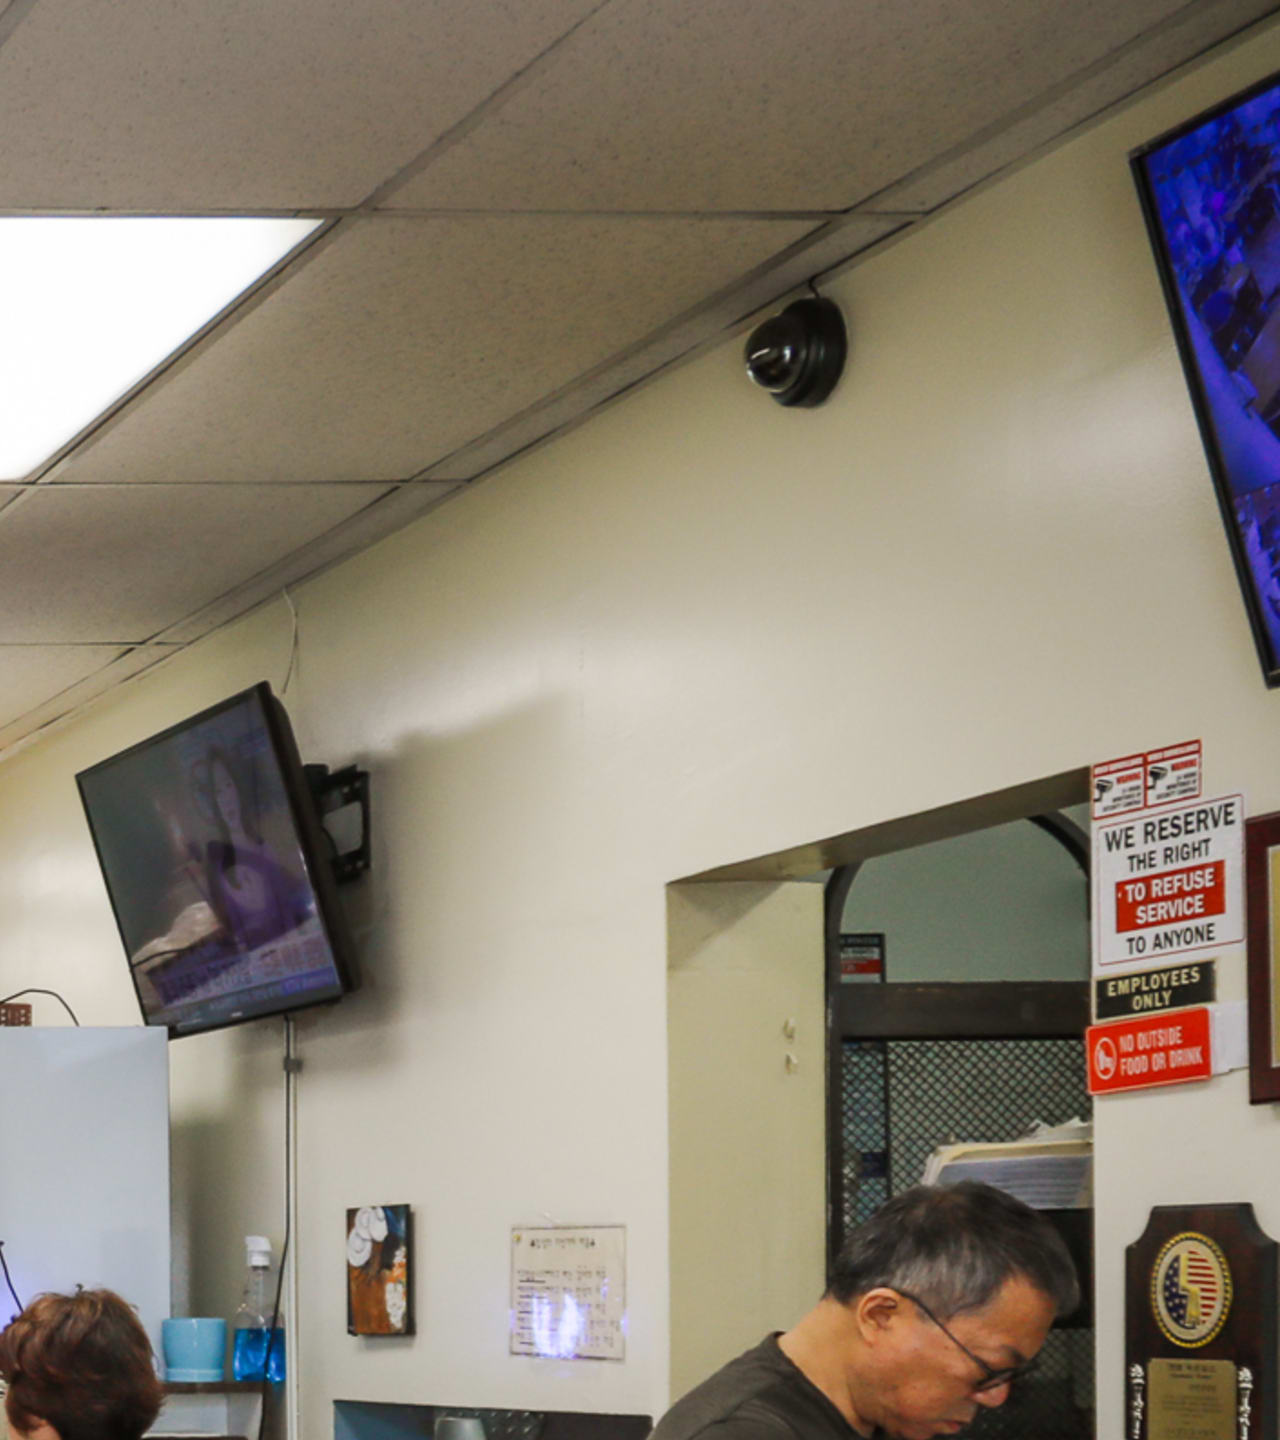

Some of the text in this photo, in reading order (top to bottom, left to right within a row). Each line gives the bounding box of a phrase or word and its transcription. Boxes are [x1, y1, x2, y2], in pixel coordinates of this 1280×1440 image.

[1105, 803, 1236, 852] WE RESERVE
[1128, 838, 1211, 872] THE RIGHT
[1125, 868, 1215, 903] TO REFUSE
[1135, 894, 1205, 925] SERVICE
[1126, 923, 1215, 955] TO ANYONE
[1107, 966, 1200, 997] EMPLOYEES
[1132, 990, 1172, 1011] ONLY
[1119, 1026, 1183, 1052] NO OUTSIDE
[1121, 1046, 1203, 1076] FOOD OR DRINK
